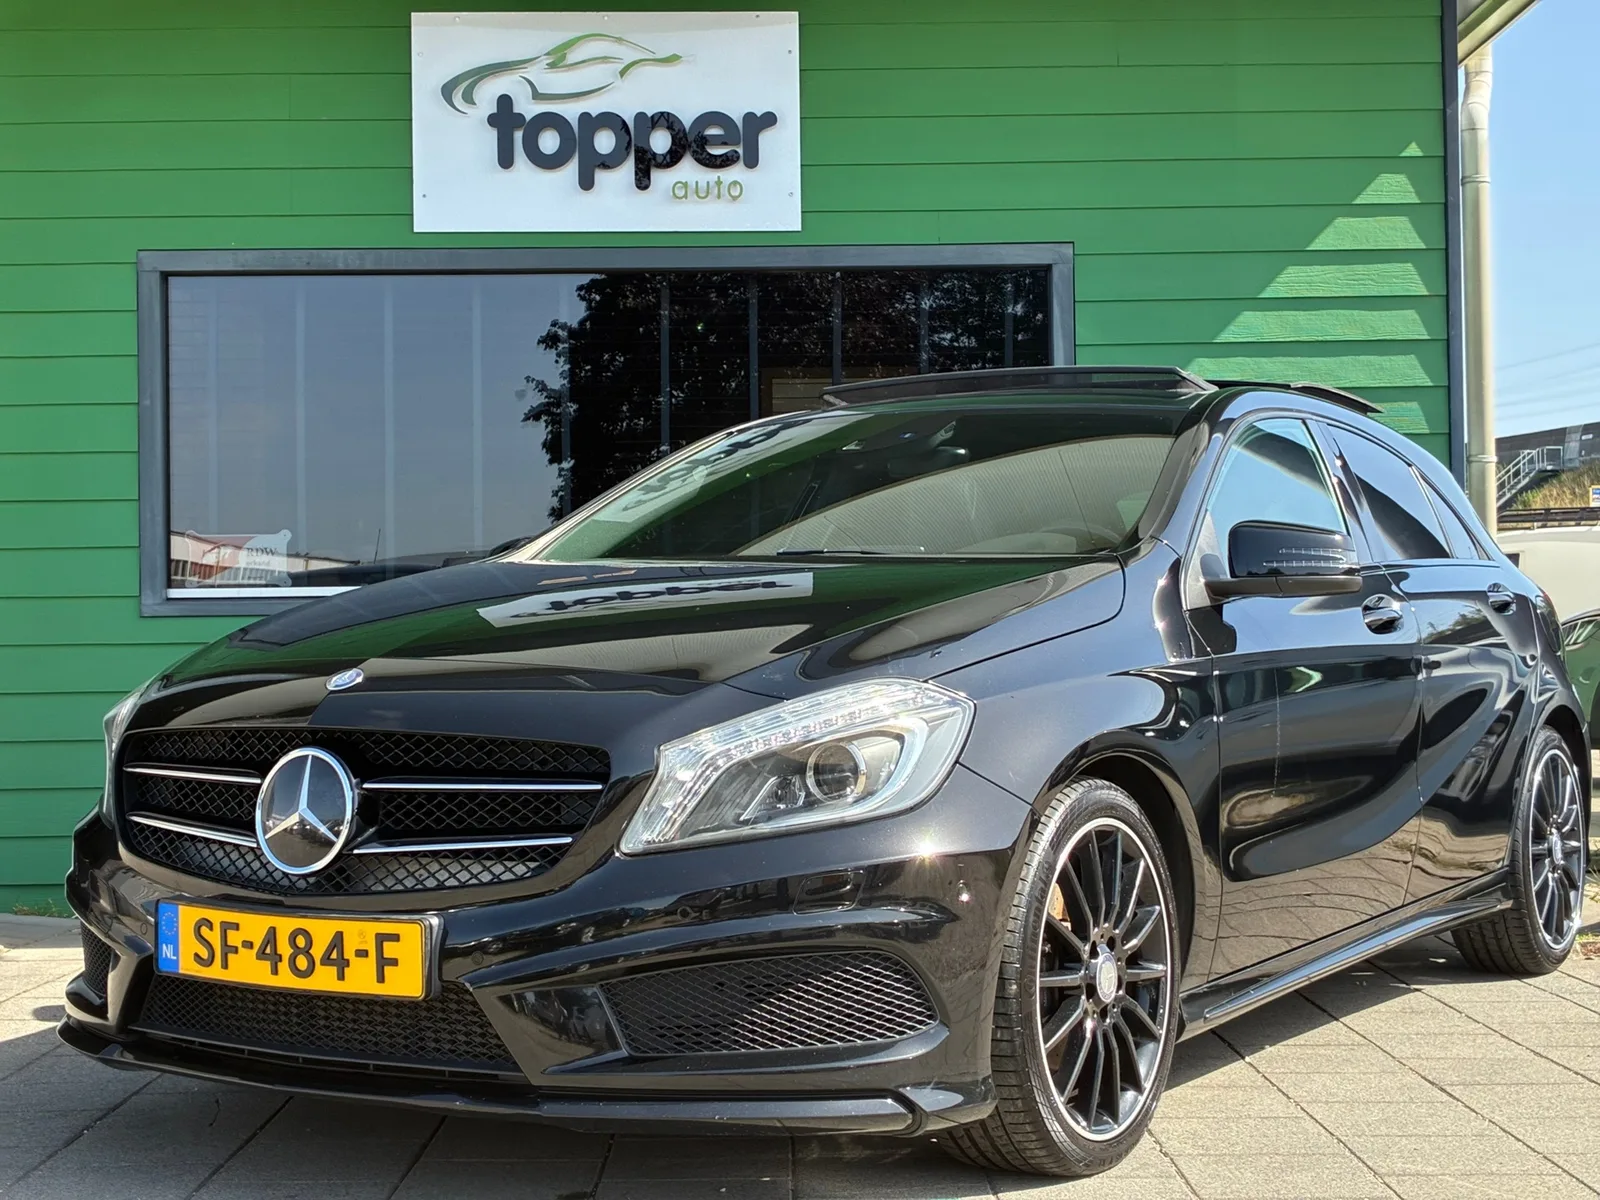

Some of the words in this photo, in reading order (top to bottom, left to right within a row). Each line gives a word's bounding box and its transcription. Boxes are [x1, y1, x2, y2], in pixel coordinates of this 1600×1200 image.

[487, 94, 778, 191] topper
[671, 175, 744, 200] auto
[246, 547, 277, 556] RDW
[162, 943, 177, 959] NL
[193, 917, 400, 984] SF-484-F
